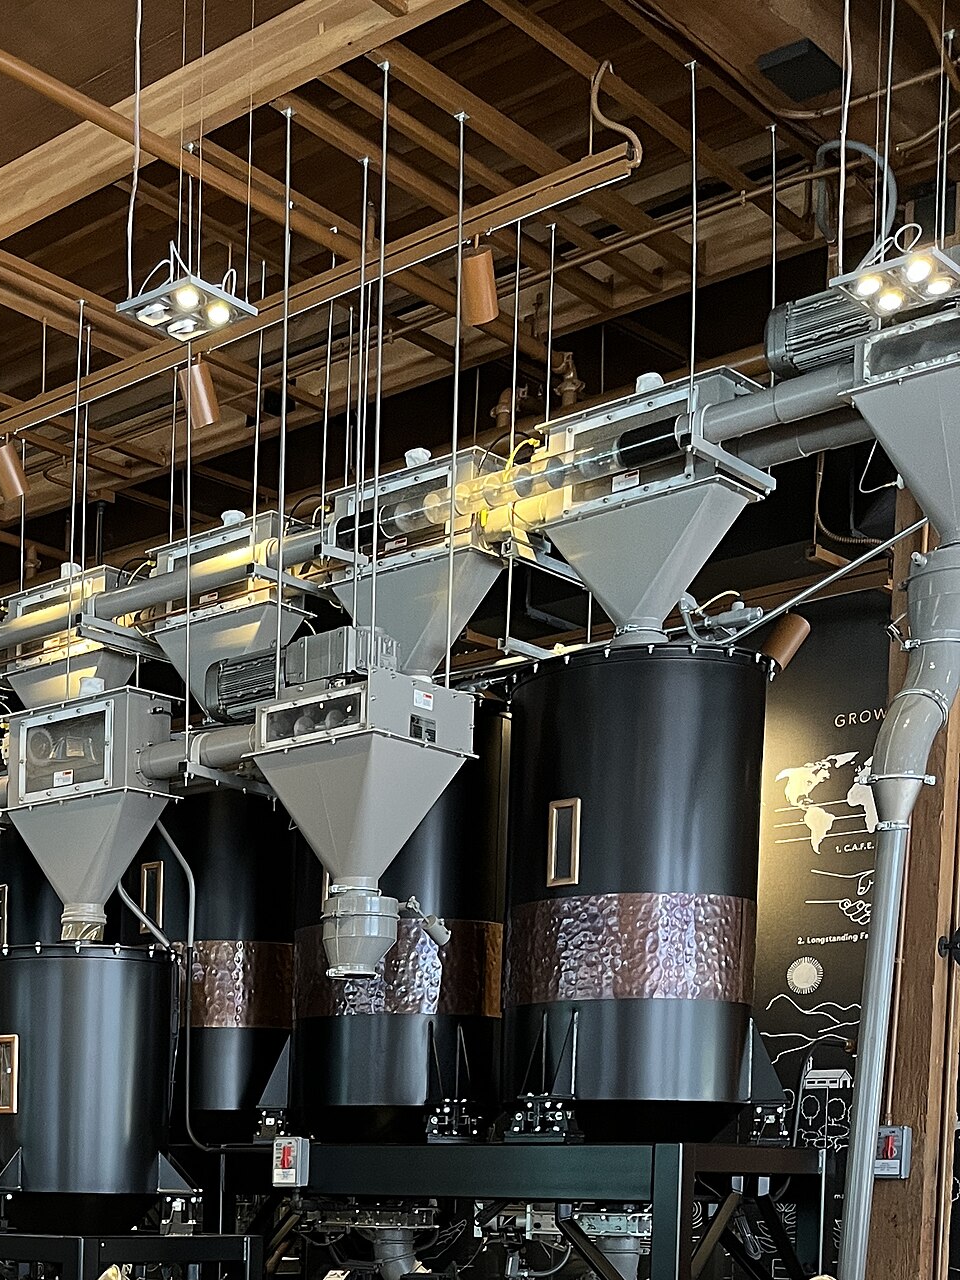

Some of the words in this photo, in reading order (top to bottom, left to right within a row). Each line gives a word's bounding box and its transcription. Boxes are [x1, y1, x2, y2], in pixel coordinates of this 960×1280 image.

[844, 842, 874, 852] C.A.F.E.
[797, 937, 805, 945] 2.
[806, 933, 858, 945] Longstanding
